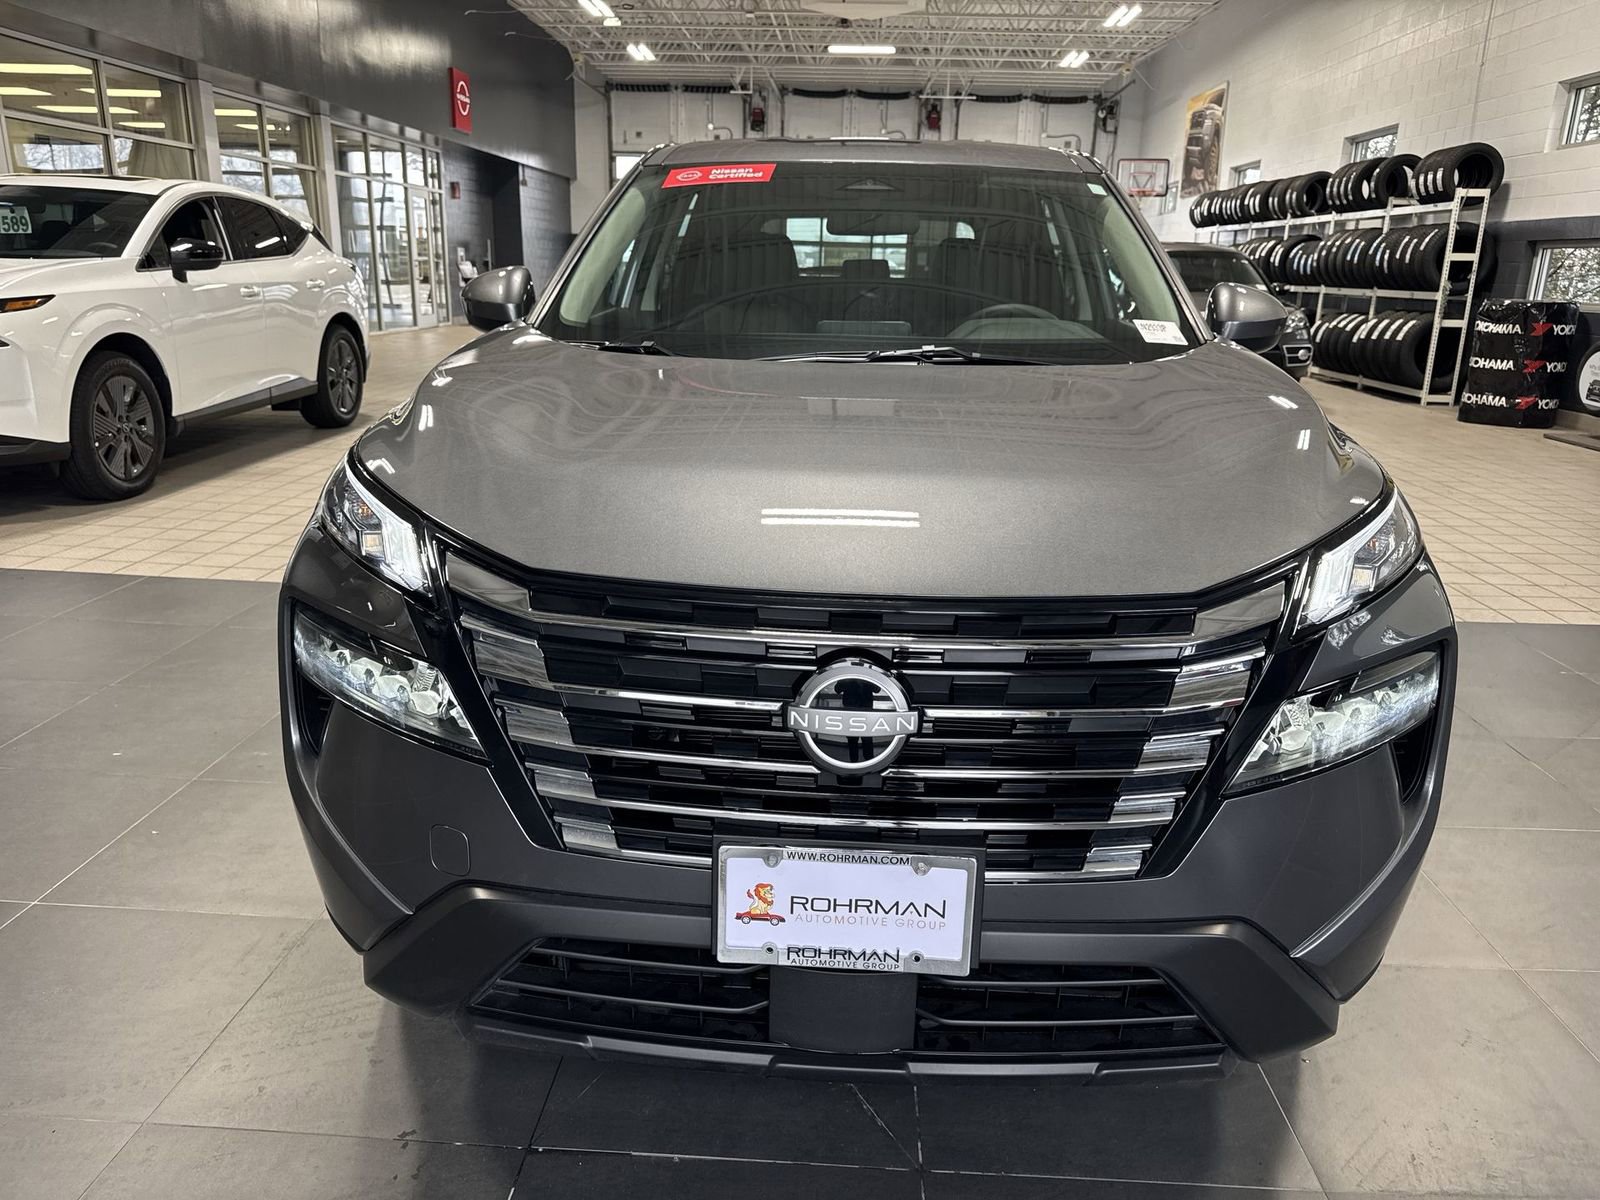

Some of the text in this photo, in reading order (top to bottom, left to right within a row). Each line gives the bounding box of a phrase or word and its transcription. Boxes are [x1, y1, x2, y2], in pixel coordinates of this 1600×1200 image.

[790, 710, 915, 732] NISSAN
[786, 851, 910, 866] WWW.ROHRMAN.COM
[790, 895, 946, 919] ROHRMAN
[795, 913, 947, 931] AUTOMOTIVE GROUP
[786, 945, 900, 964] ROHRMAN
[790, 958, 900, 971] AUTOMOTIVE GROUP
